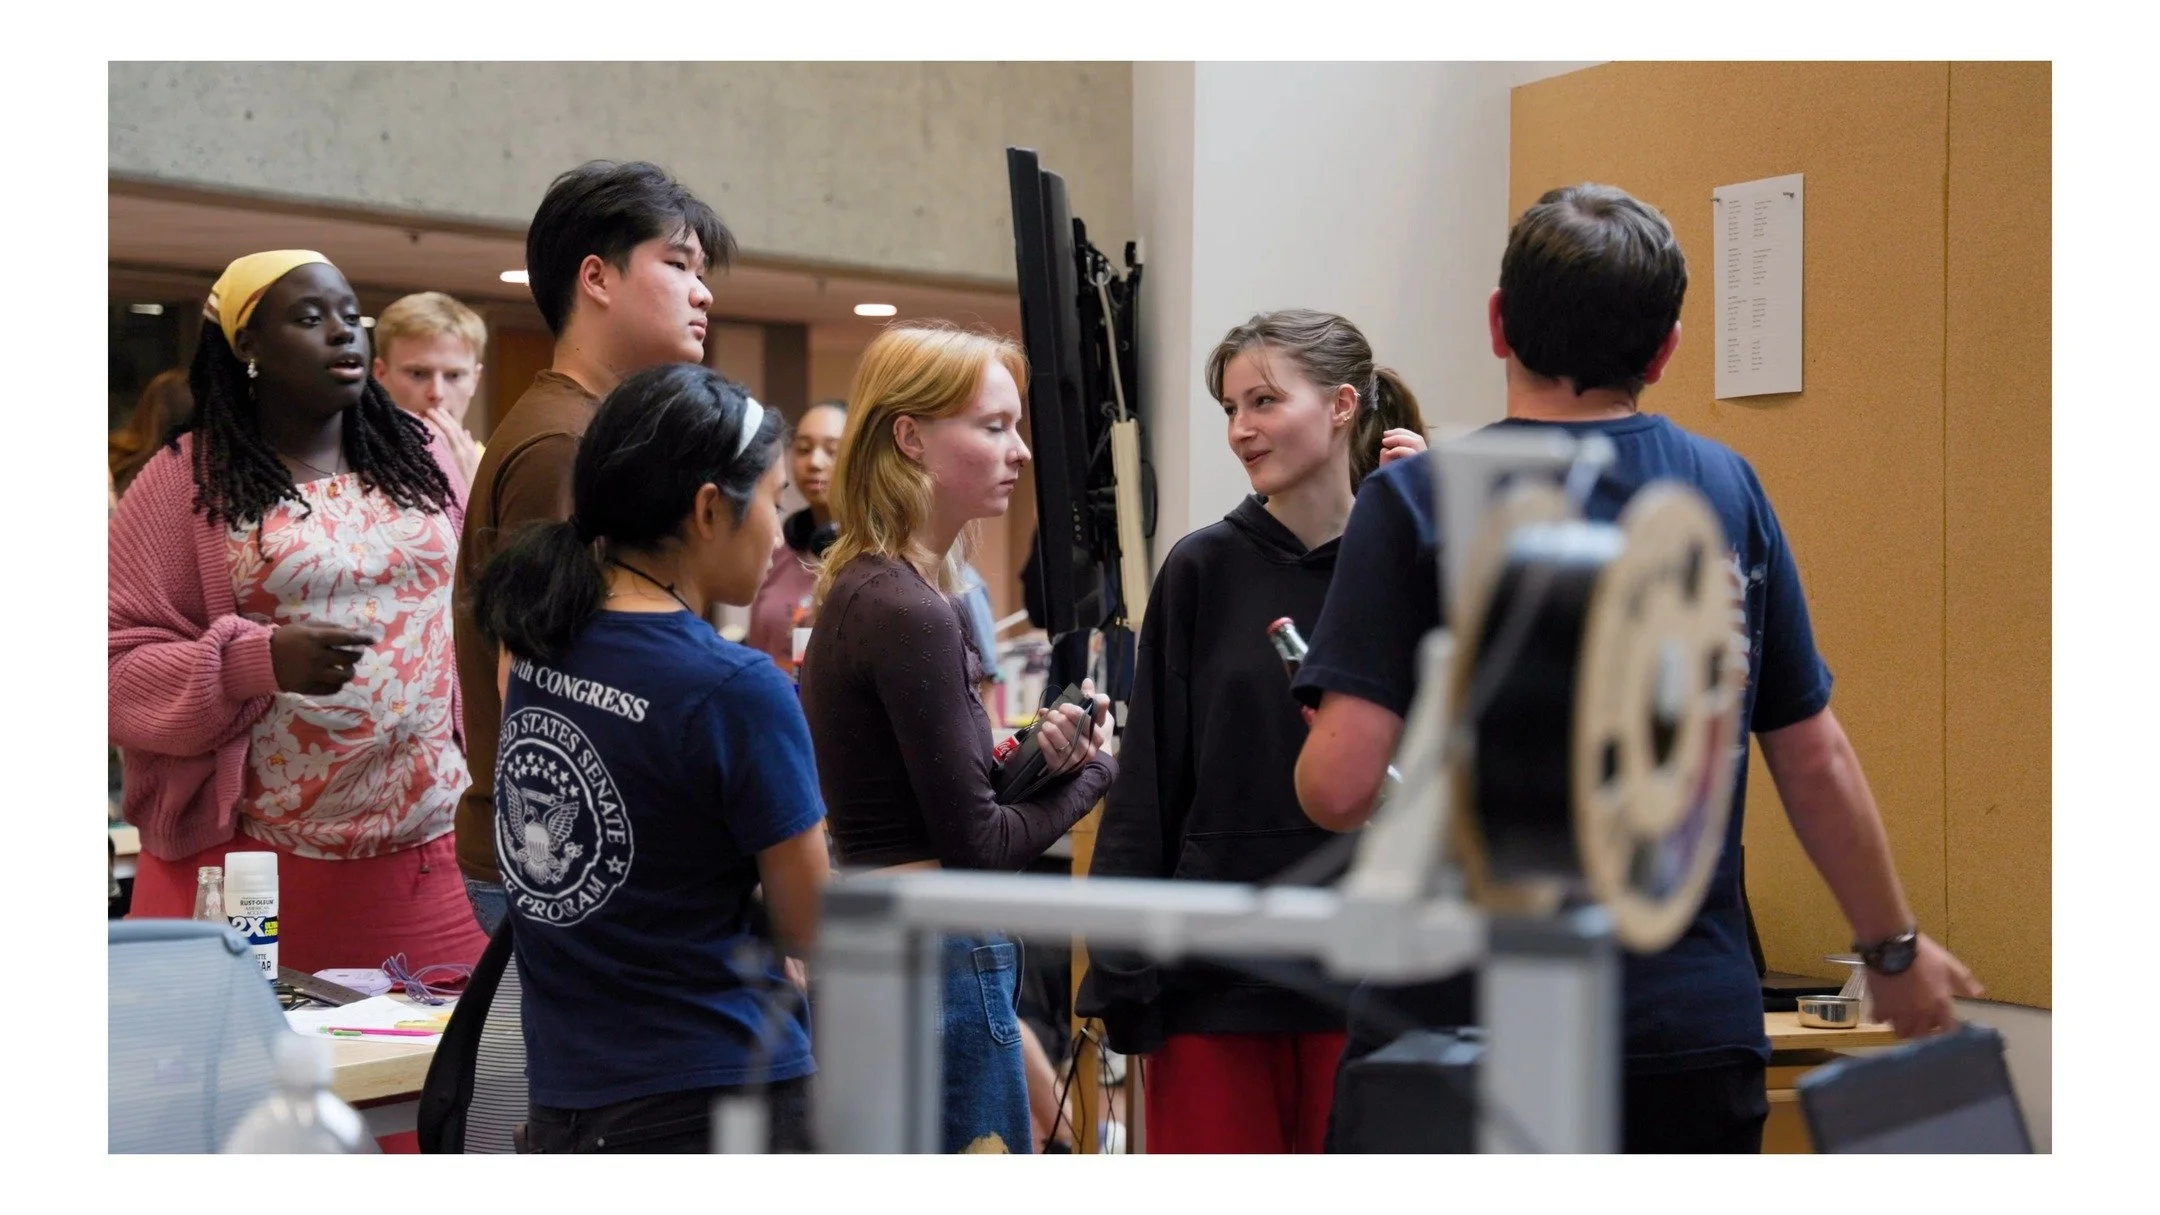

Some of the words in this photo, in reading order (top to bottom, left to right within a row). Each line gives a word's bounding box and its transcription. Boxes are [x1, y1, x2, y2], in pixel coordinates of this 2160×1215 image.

[535, 665, 650, 723] CONGRESS
[520, 712, 581, 754] STATES
[577, 749, 626, 845] SENATE
[232, 916, 265, 937] 2X
